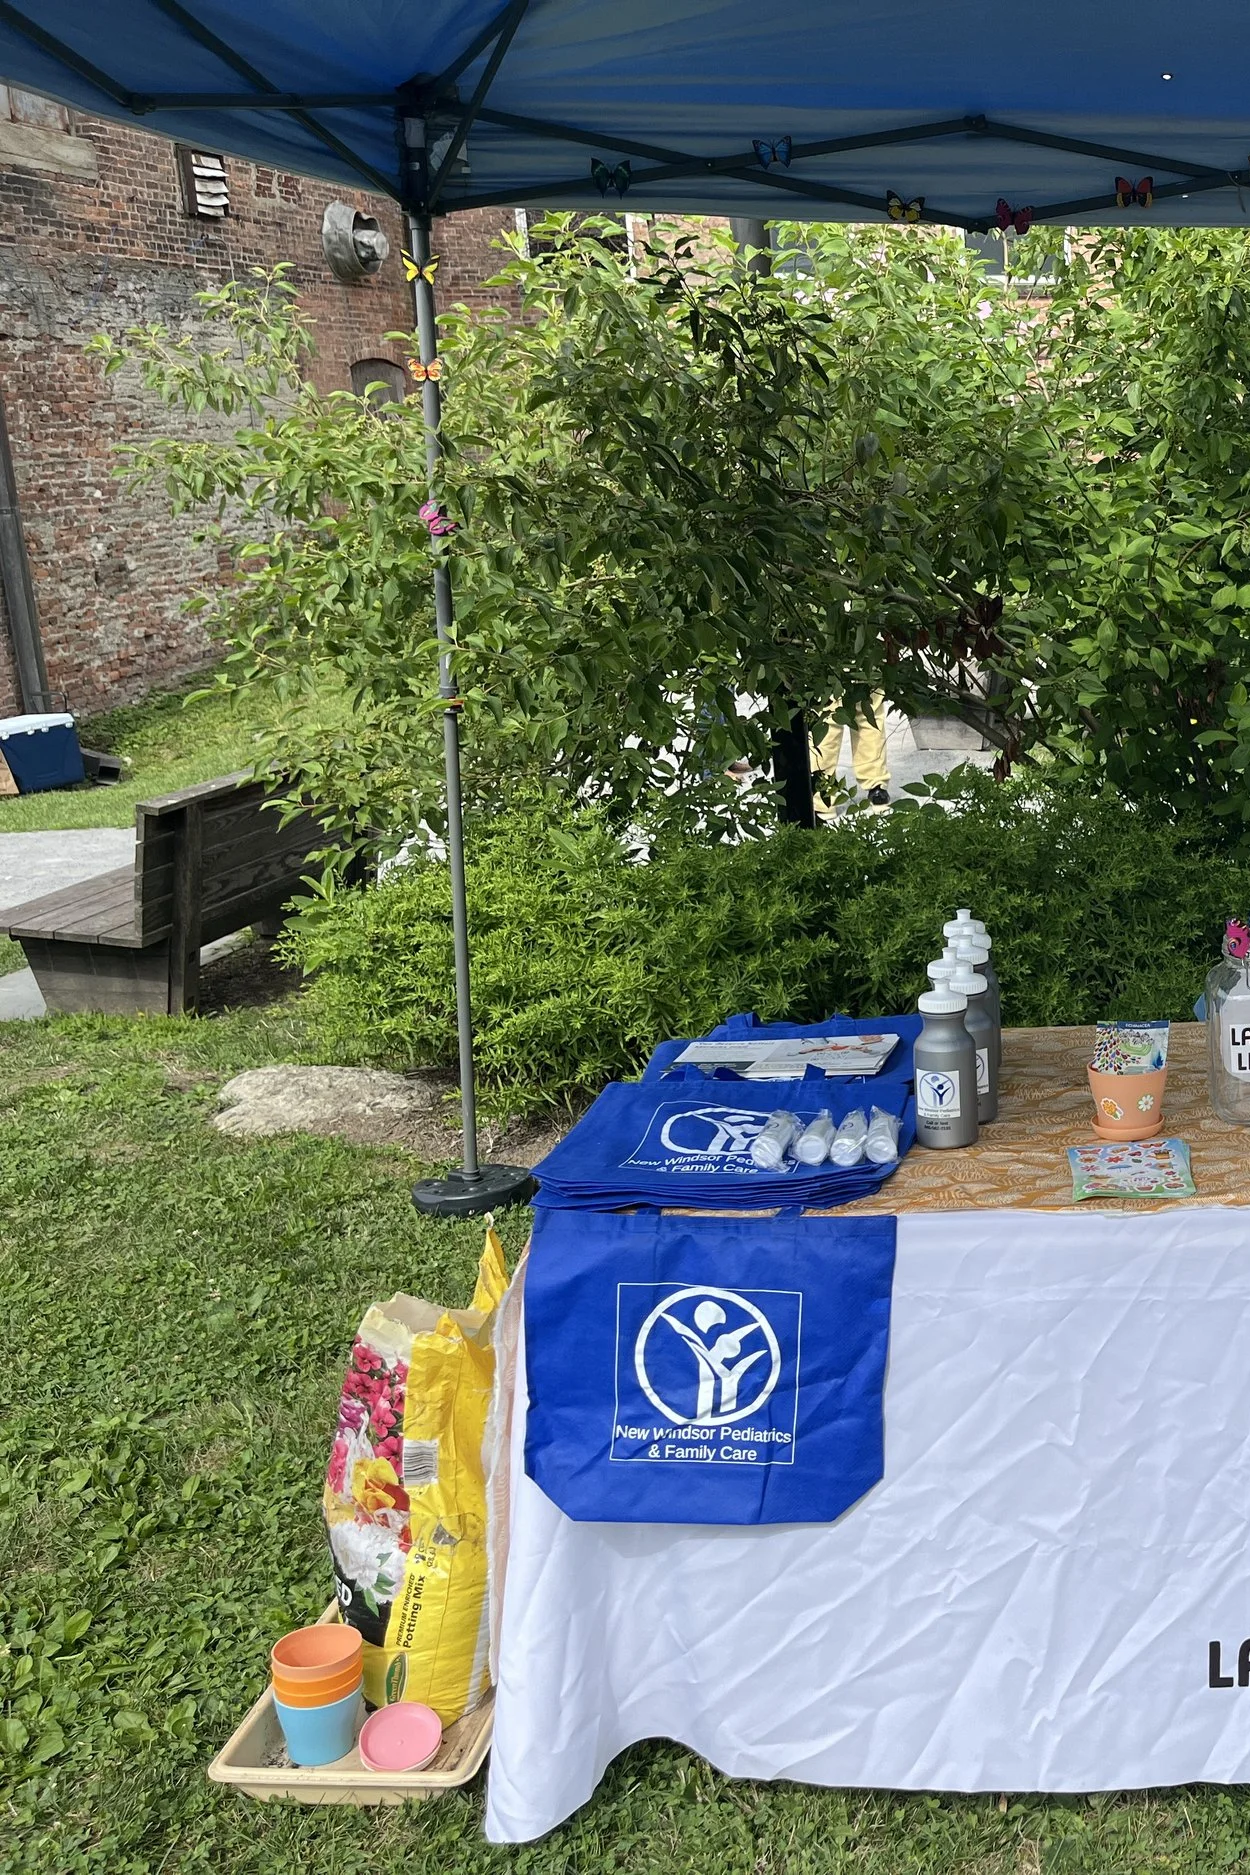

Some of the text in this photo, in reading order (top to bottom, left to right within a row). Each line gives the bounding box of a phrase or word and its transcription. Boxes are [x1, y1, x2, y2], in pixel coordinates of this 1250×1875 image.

[627, 1158, 663, 1167] New
[665, 1154, 726, 1165] Windsor
[672, 1164, 719, 1173] Family
[723, 1165, 759, 1174] Care
[615, 1425, 792, 1444] New Windsor Pediatrics
[648, 1444, 758, 1461] & Family Care
[396, 1573, 415, 1646] PREMIUM ENRICHED
[403, 1602, 422, 1649] Potting
[413, 1575, 426, 1600] Mix
